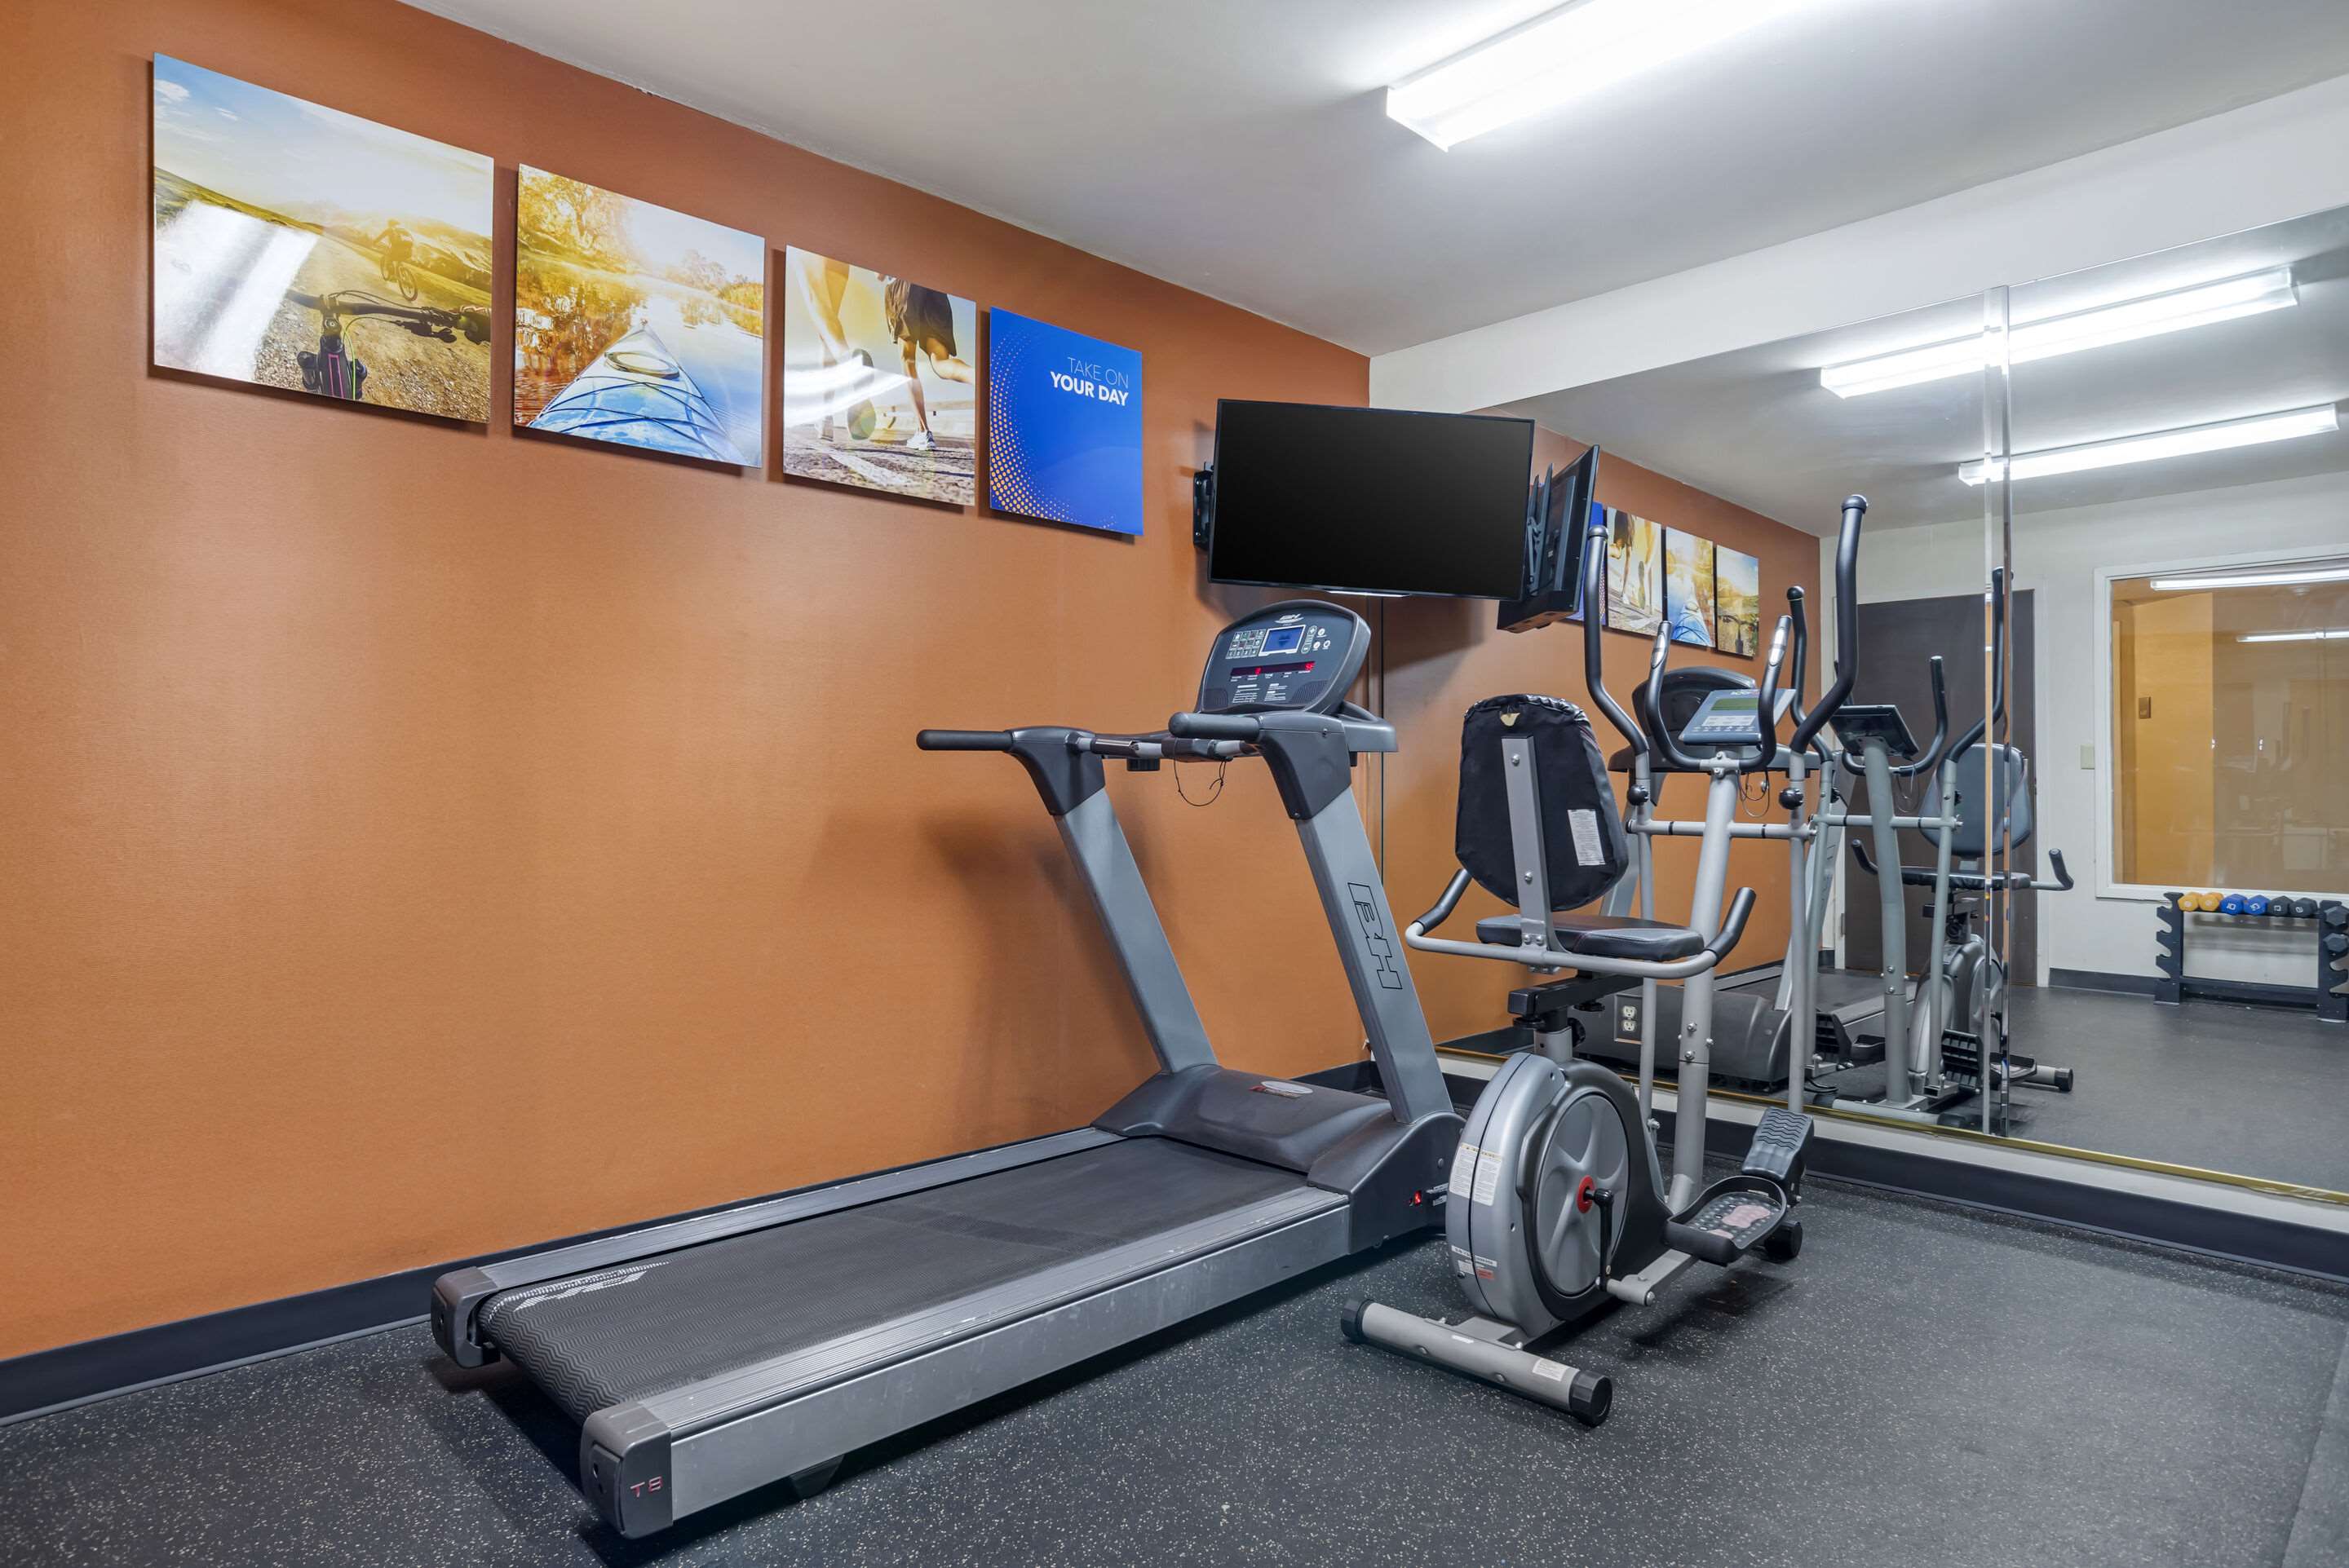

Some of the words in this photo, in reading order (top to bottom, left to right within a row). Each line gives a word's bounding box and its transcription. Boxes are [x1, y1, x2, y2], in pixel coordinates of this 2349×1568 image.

[1051, 371, 1095, 398] YOUR
[1098, 384, 1129, 406] DAY
[1068, 357, 1102, 381] TAKE
[1106, 369, 1129, 388] ON
